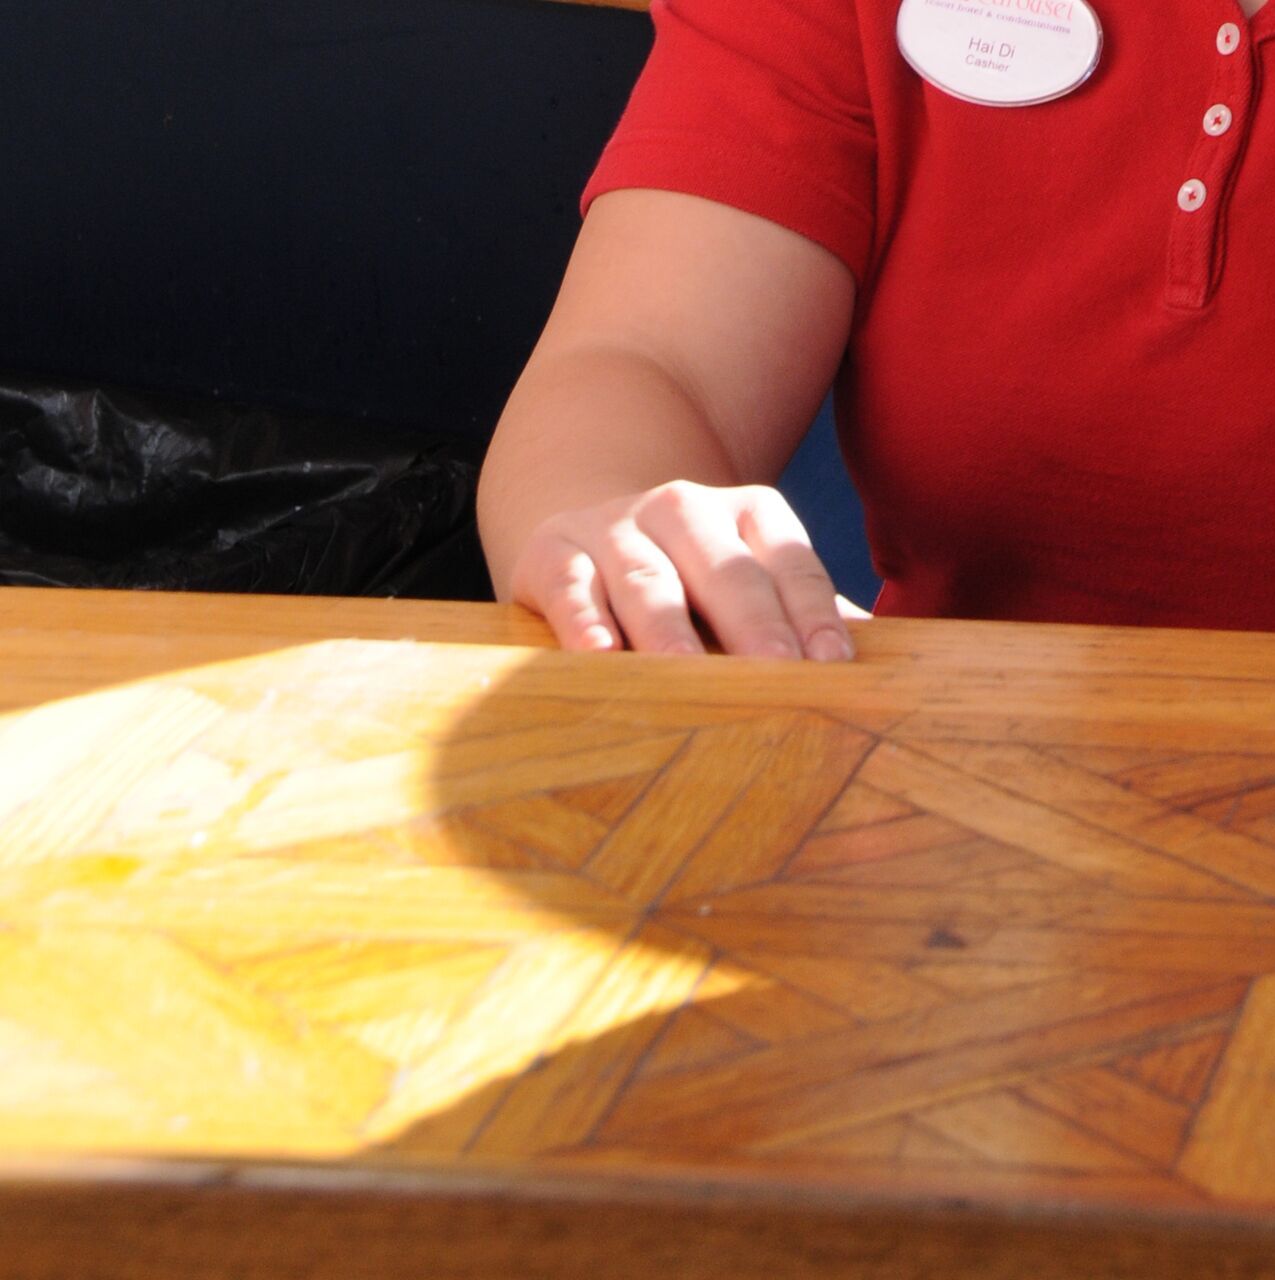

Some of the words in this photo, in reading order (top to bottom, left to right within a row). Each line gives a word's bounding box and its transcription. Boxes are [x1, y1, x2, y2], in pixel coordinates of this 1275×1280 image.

[968, 36, 995, 55] Hai
[999, 43, 1016, 59] Di
[964, 54, 1011, 73] Cashier
